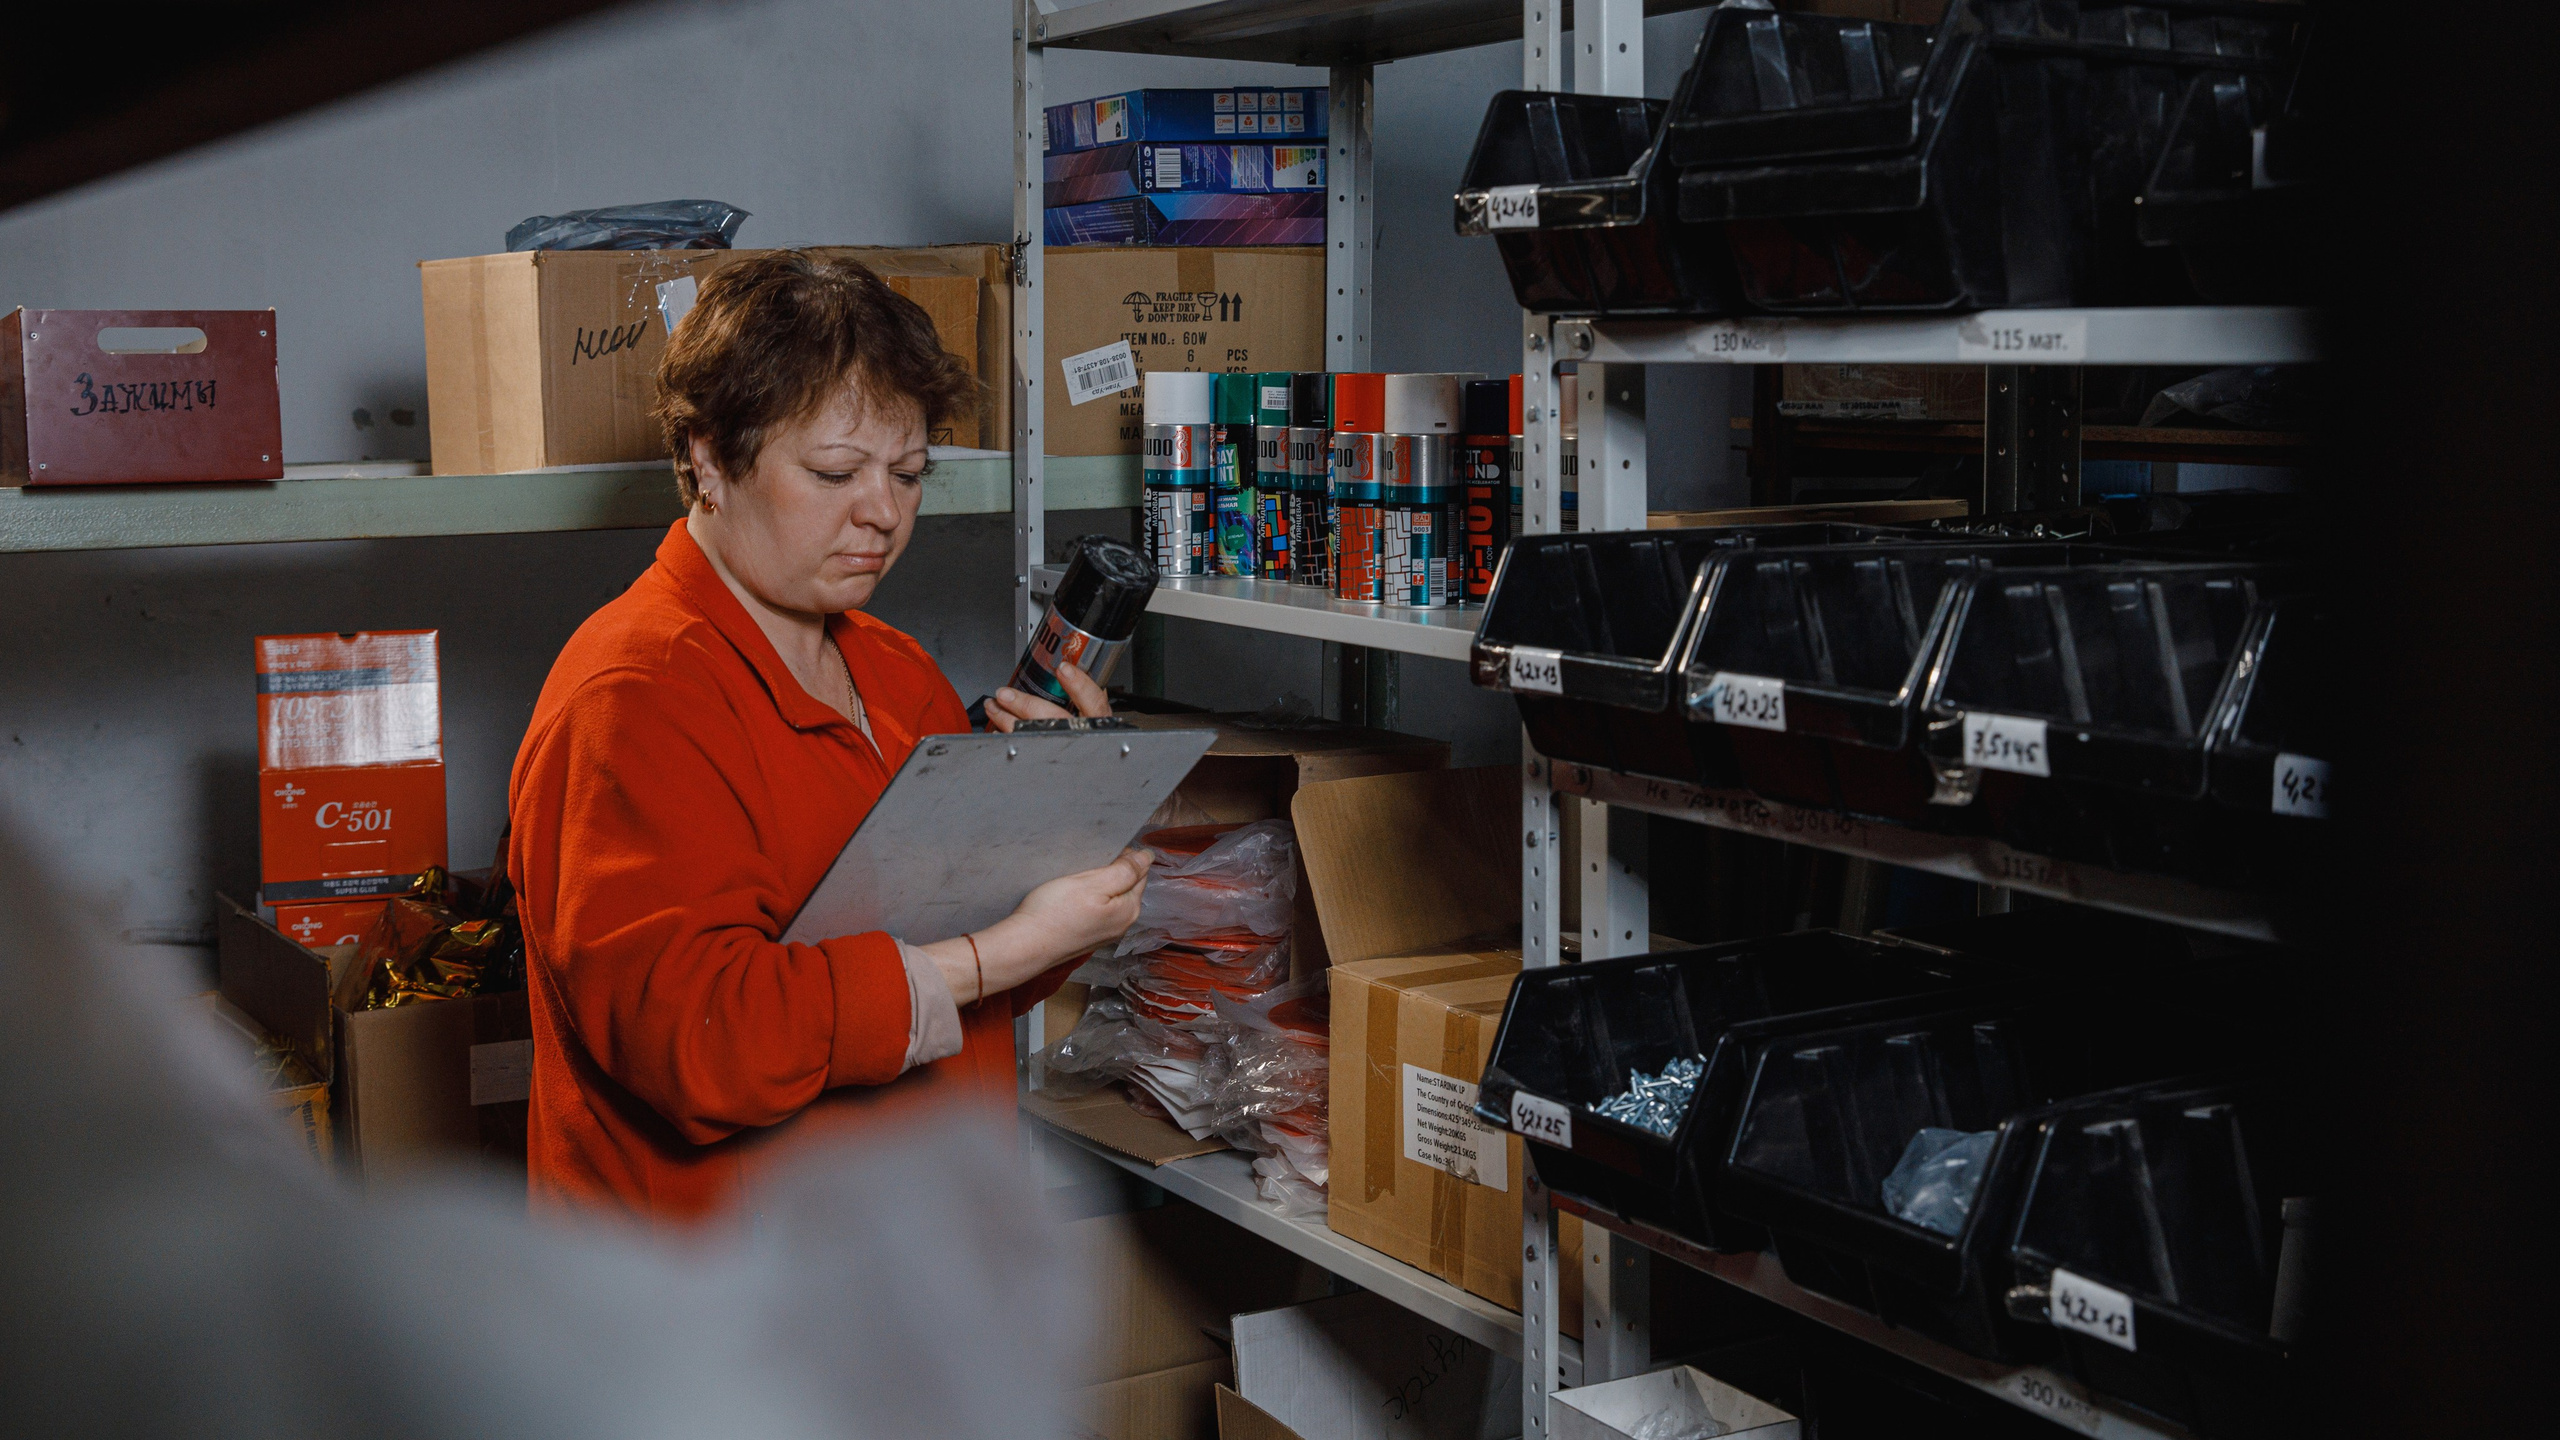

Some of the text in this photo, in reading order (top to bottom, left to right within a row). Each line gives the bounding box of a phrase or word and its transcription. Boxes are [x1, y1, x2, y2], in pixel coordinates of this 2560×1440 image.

[1155, 292, 1194, 302] FRAGILE
[1152, 302, 1197, 313] KEEP DRY
[1147, 312, 1200, 323] DON'T DROP
[1120, 332, 1148, 346] ITEM
[1182, 331, 1208, 346] 60W
[1713, 332, 1739, 352] 130
[1992, 328, 2024, 351] 115
[1187, 349, 1195, 363] 6
[1226, 348, 1249, 362] PCS
[1295, 497, 1303, 543] ГЛЯНЦЕВАЯ
[314, 801, 393, 833] C-501
[1416, 1087, 1427, 1099] The
[1427, 1091, 1450, 1108] Country
[1449, 1098, 1457, 1108] of
[1416, 1118, 1428, 1130] Net
[1417, 1133, 1433, 1146] Gross
[1417, 1148, 1432, 1161] Case
[2020, 1375, 2053, 1406] 300
